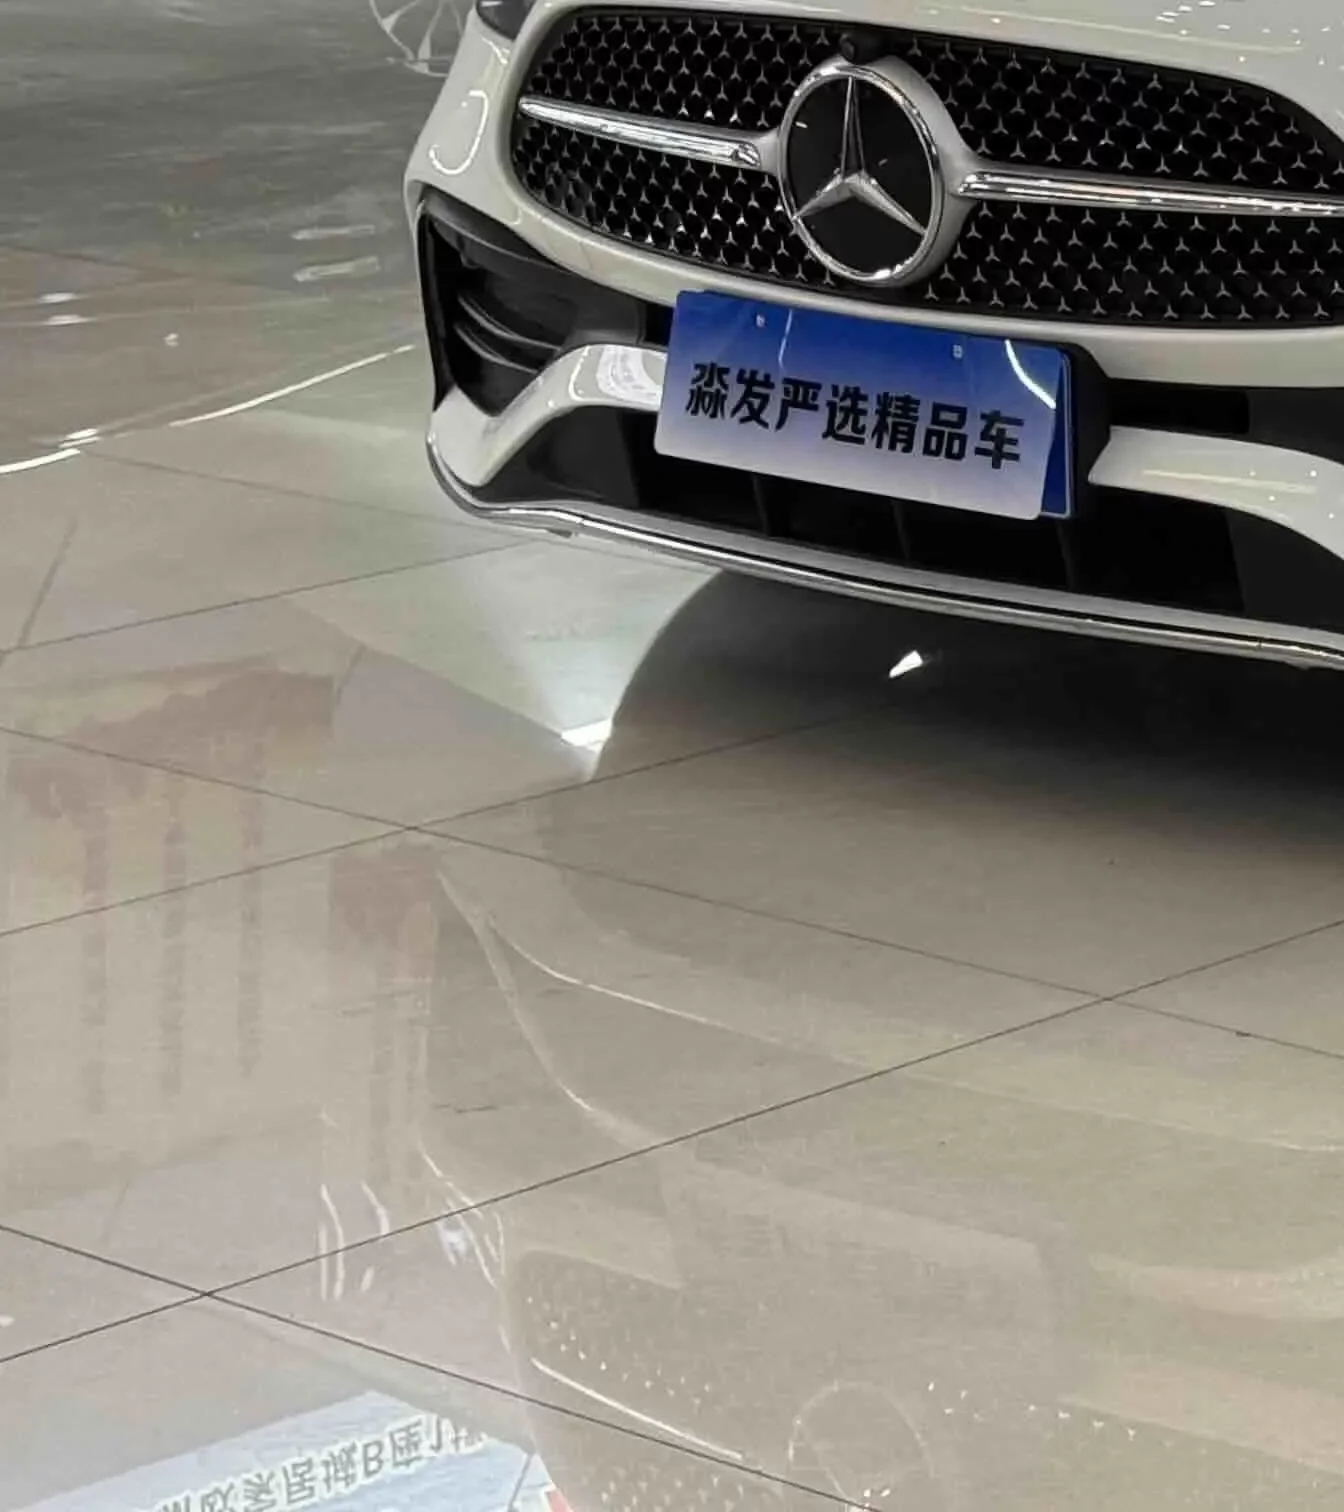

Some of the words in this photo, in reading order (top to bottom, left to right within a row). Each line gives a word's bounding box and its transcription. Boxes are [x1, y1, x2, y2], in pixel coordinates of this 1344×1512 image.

[686, 361, 1026, 469] 淼发严选精品车
